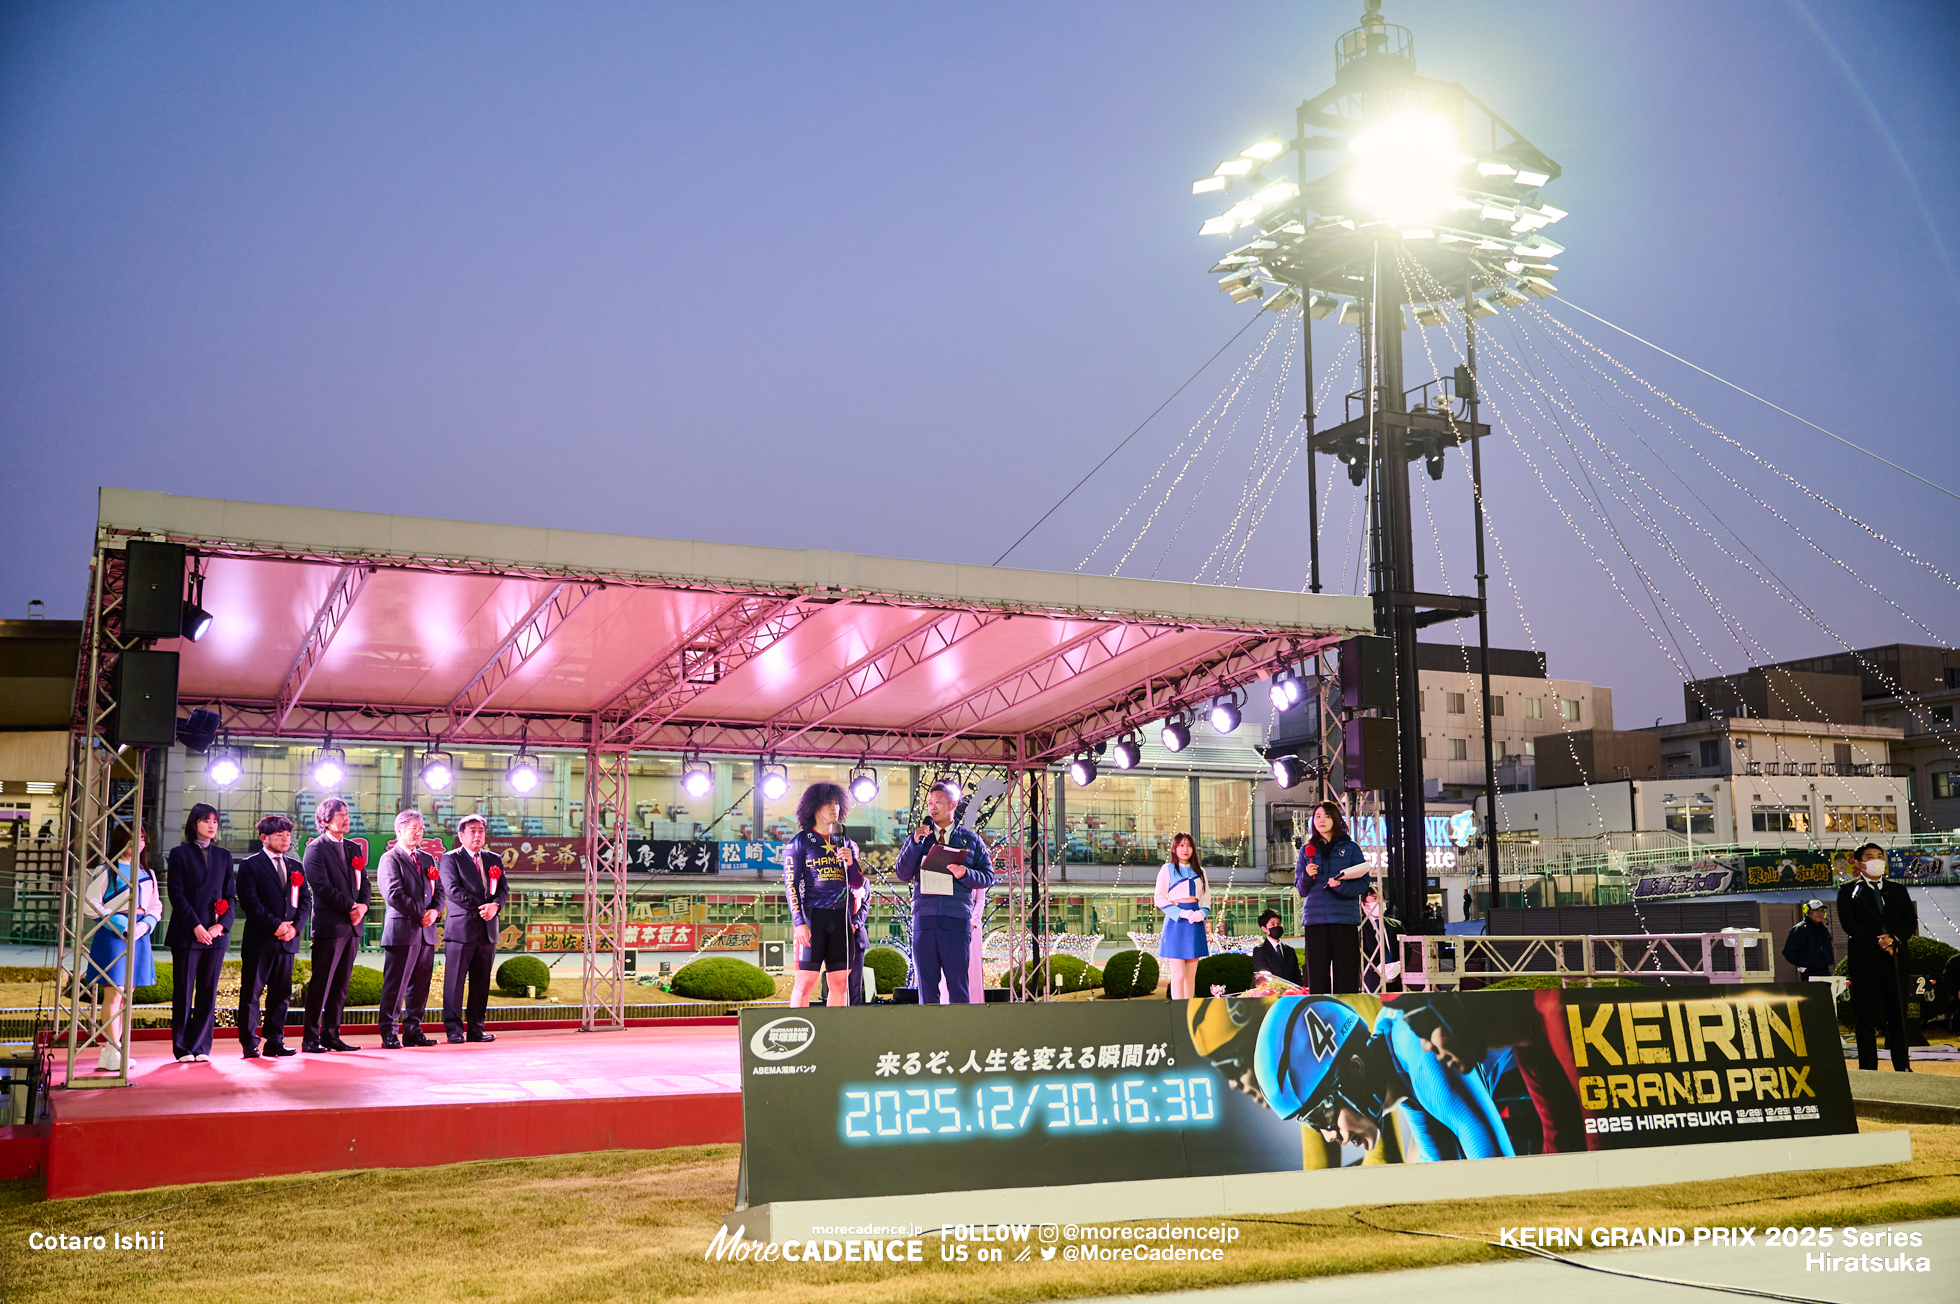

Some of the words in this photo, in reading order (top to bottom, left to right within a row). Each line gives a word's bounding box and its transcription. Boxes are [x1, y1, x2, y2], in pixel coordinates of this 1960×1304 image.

[805, 856, 843, 867] CHAMP
[1426, 847, 1456, 868] ate
[784, 856, 801, 914] CHAMPION
[1915, 976, 1926, 994] 2
[1304, 1007, 1338, 1062] 4
[1566, 998, 1808, 1068] KEIRIN
[875, 1042, 1176, 1077] 来るぞ、人生を変える瞬間が。
[1578, 1070, 1722, 1110] GRAND
[1726, 1065, 1816, 1102] PRIX
[1585, 1116, 1634, 1134] 2025
[1636, 1110, 1734, 1131] HIRATSUKA
